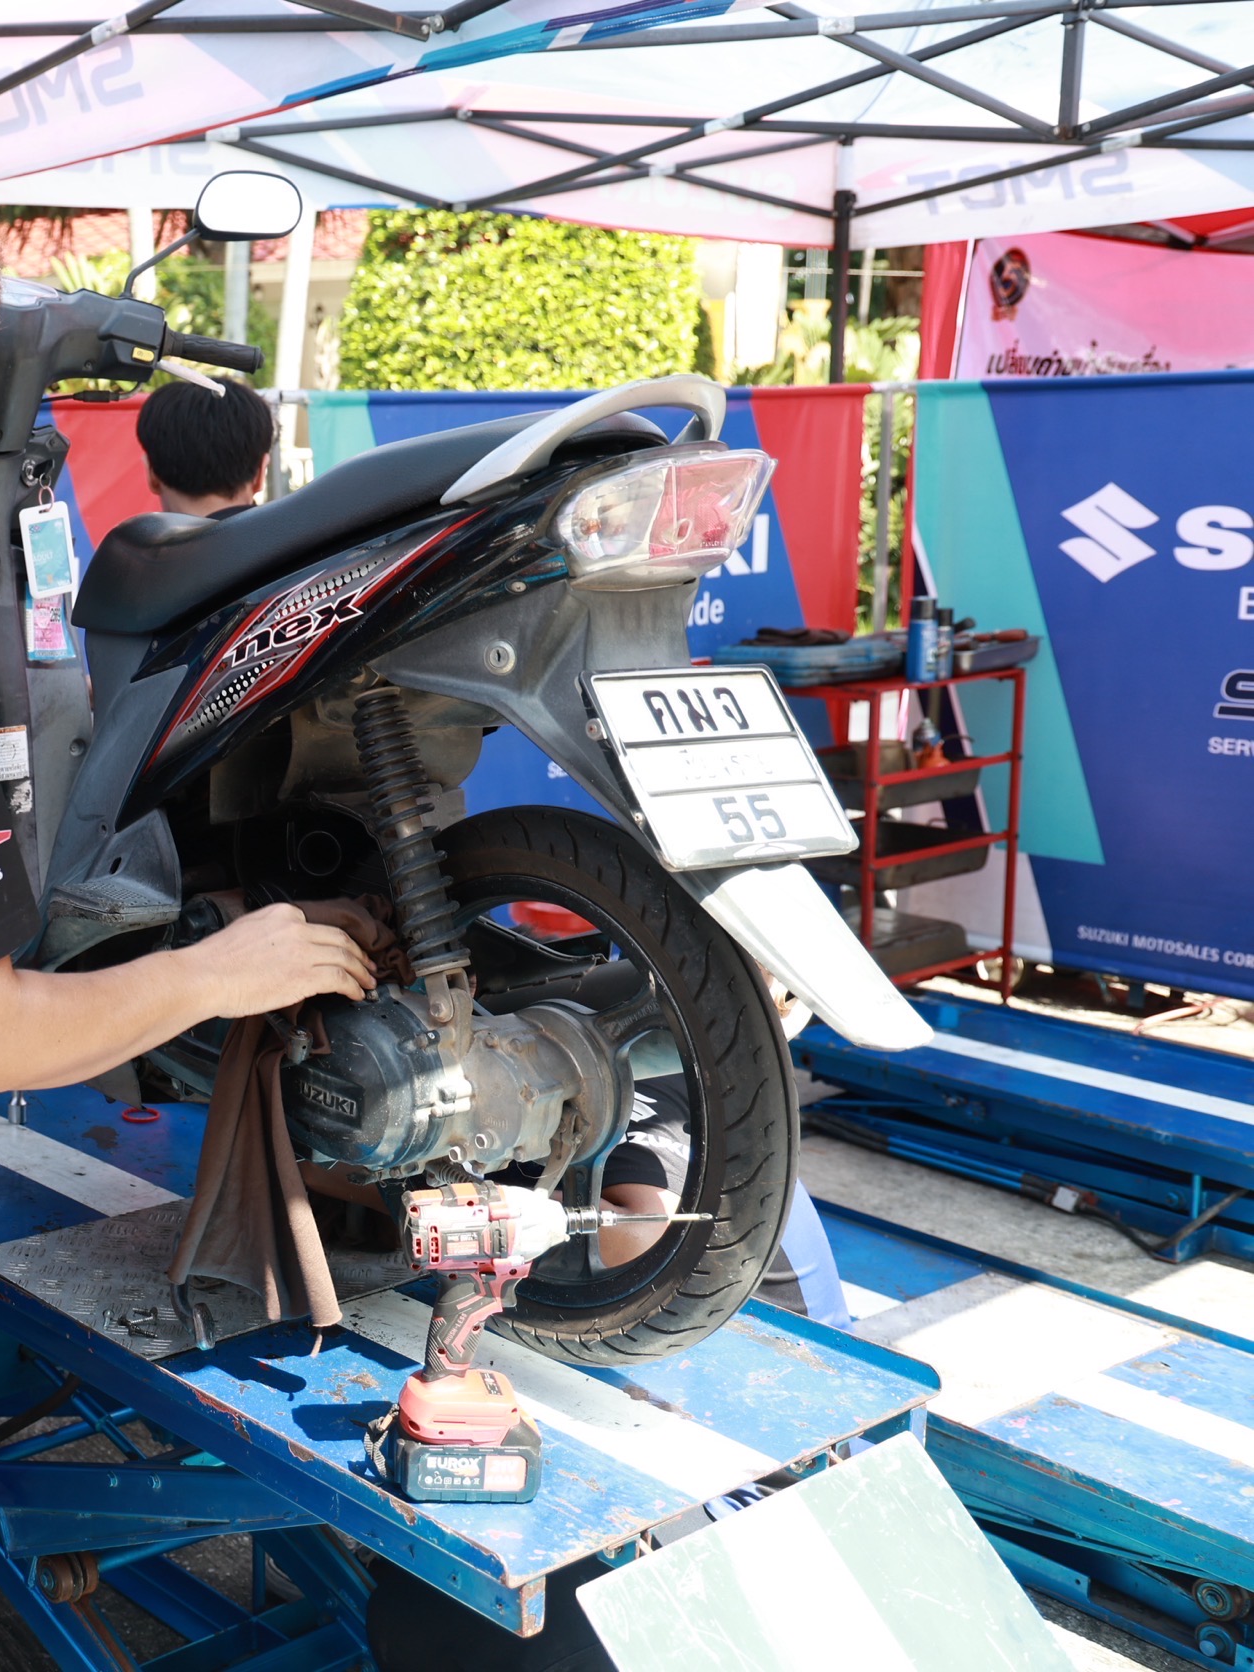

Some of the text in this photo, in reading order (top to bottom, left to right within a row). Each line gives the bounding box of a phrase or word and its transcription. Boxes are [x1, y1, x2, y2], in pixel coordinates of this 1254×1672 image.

[712, 794, 787, 843] 55
[1077, 925, 1128, 947] SUZUKI
[1132, 935, 1220, 963] MOTOSALES
